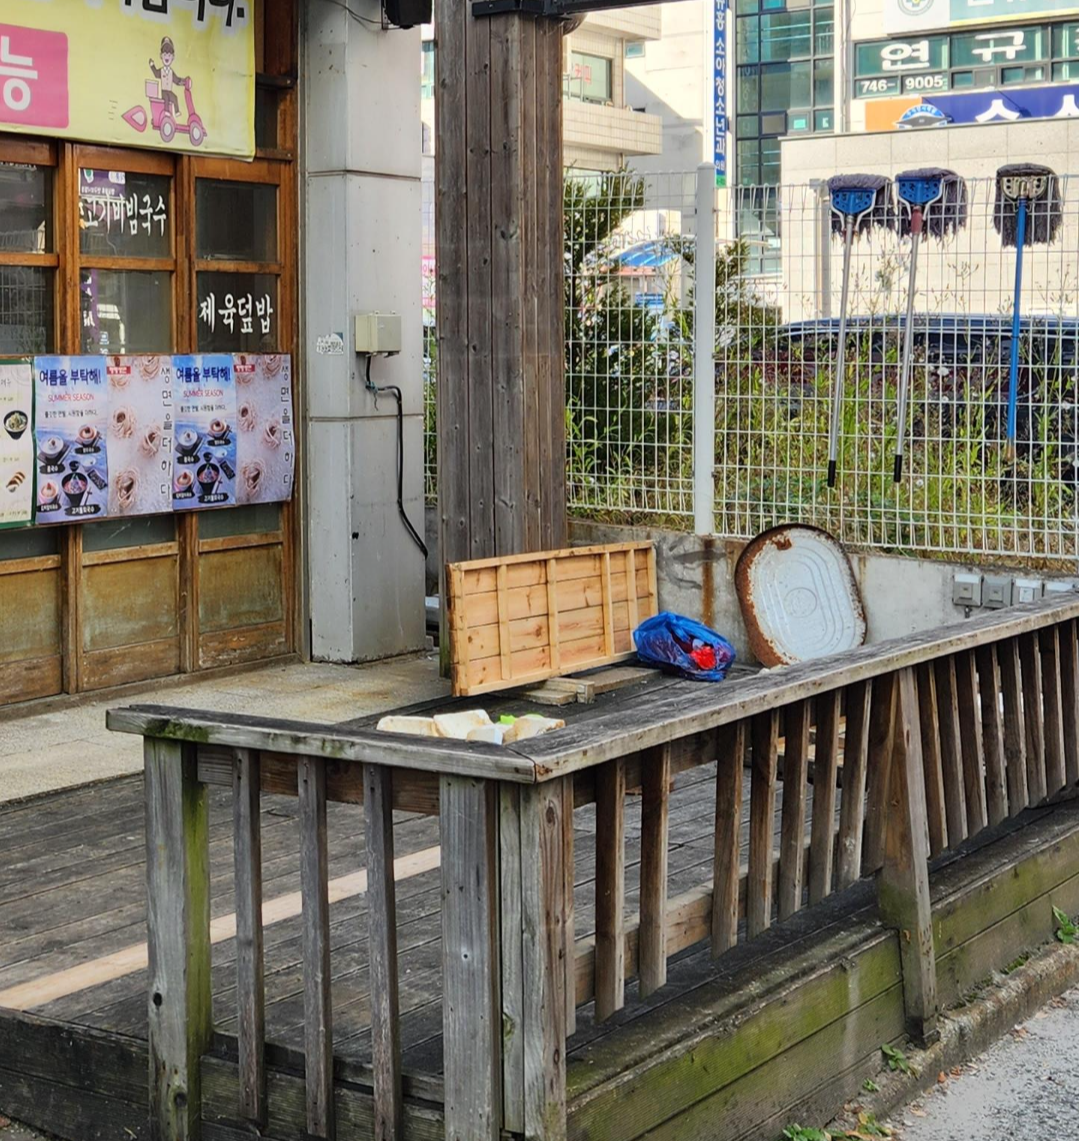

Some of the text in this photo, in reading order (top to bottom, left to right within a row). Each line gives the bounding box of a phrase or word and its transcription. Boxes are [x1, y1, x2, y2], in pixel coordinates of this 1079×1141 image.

[199, 292, 274, 334] 제육덮밥
[39, 369, 68, 386] 여름을
[73, 393, 94, 401] SEASON
[205, 389, 224, 397] SEASON
